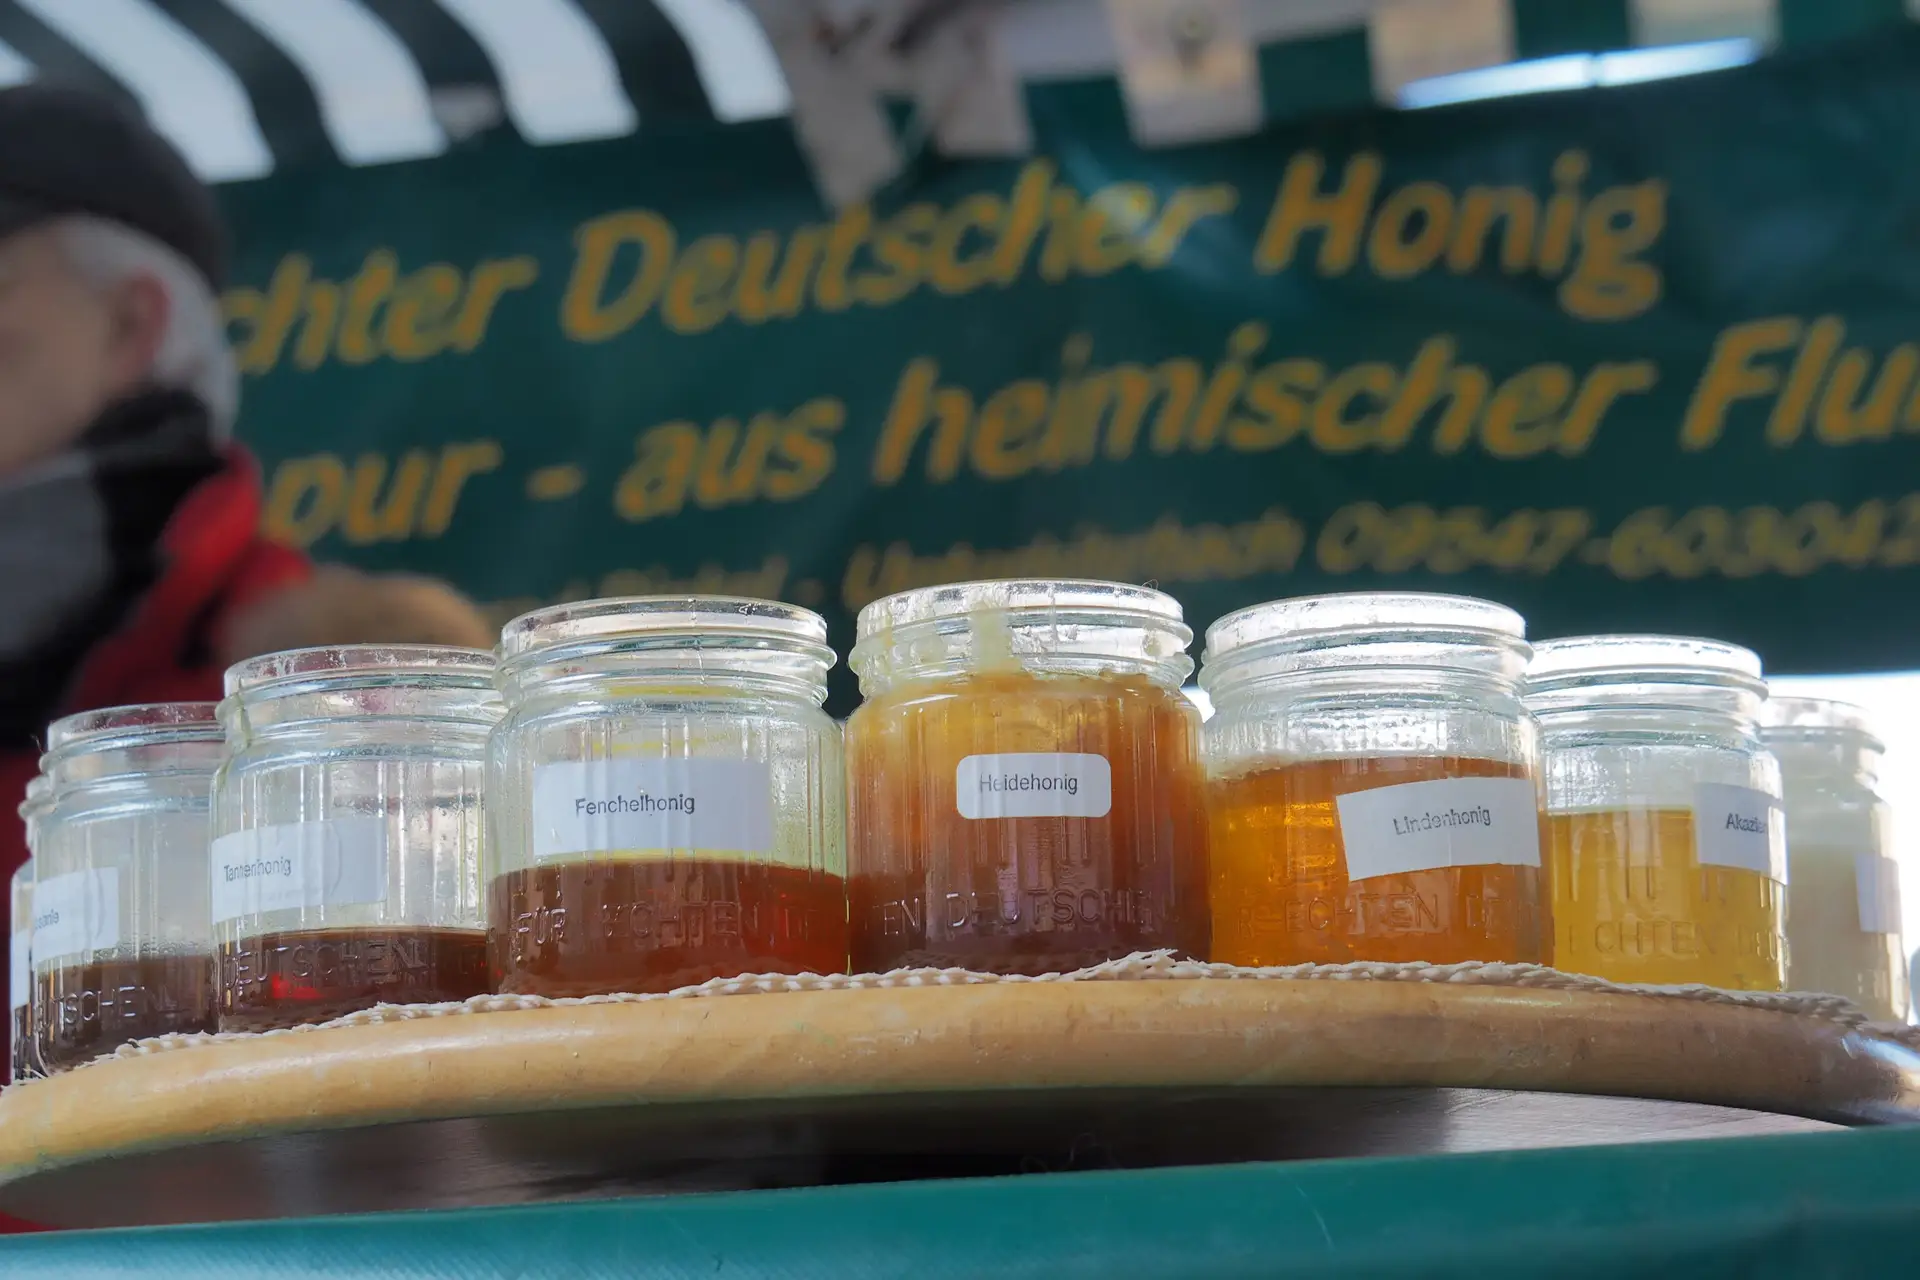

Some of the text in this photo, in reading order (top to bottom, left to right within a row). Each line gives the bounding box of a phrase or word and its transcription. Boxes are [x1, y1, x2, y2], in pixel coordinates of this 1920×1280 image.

[561, 158, 1238, 343] Deutscher
[1254, 149, 1668, 321] Honig
[614, 395, 846, 524] aus
[873, 322, 1656, 484] heimischer
[1680, 313, 1920, 451] Flu
[979, 774, 1078, 795] Heidehonig
[575, 793, 696, 817] Fenchelhonig
[1393, 806, 1491, 835] Lindenhonig
[223, 856, 292, 882] Tannenhonig
